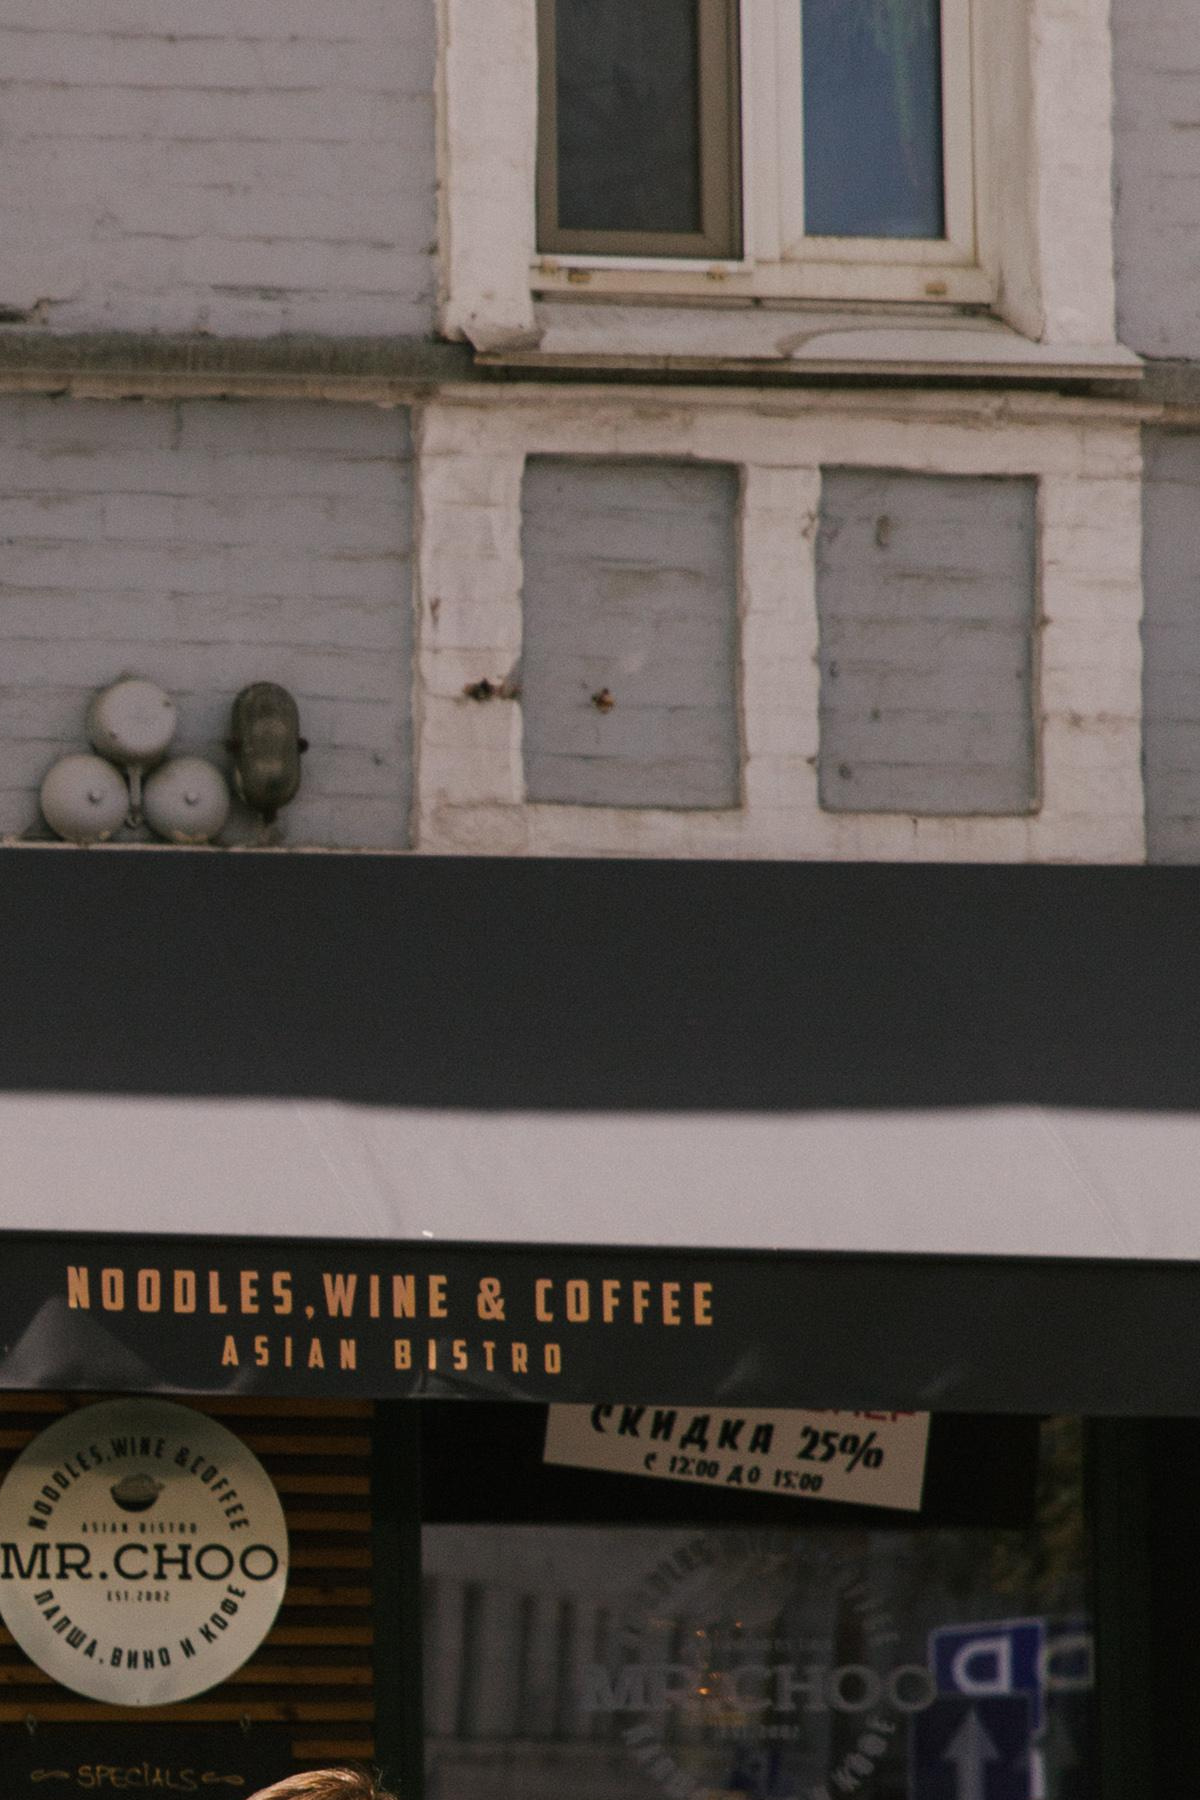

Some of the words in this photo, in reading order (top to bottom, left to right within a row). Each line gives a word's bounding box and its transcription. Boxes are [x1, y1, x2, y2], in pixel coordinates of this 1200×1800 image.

[476, 1276, 505, 1321] &
[534, 1278, 713, 1325] COFFEE
[220, 1334, 357, 1370] ASIAN
[394, 1338, 561, 1374] BISTRO
[590, 1403, 775, 1455] СКИДКА
[797, 1426, 885, 1473] 25%
[668, 1455, 721, 1479] 12:00
[725, 1464, 762, 1487] ДО
[774, 1468, 825, 1493] 15:00
[81, 1520, 129, 1535] ASIAN
[138, 1520, 198, 1536] BISTRO
[0, 1542, 280, 1582] MR.CHOO
[198, 1583, 247, 1644] КОФЕ
